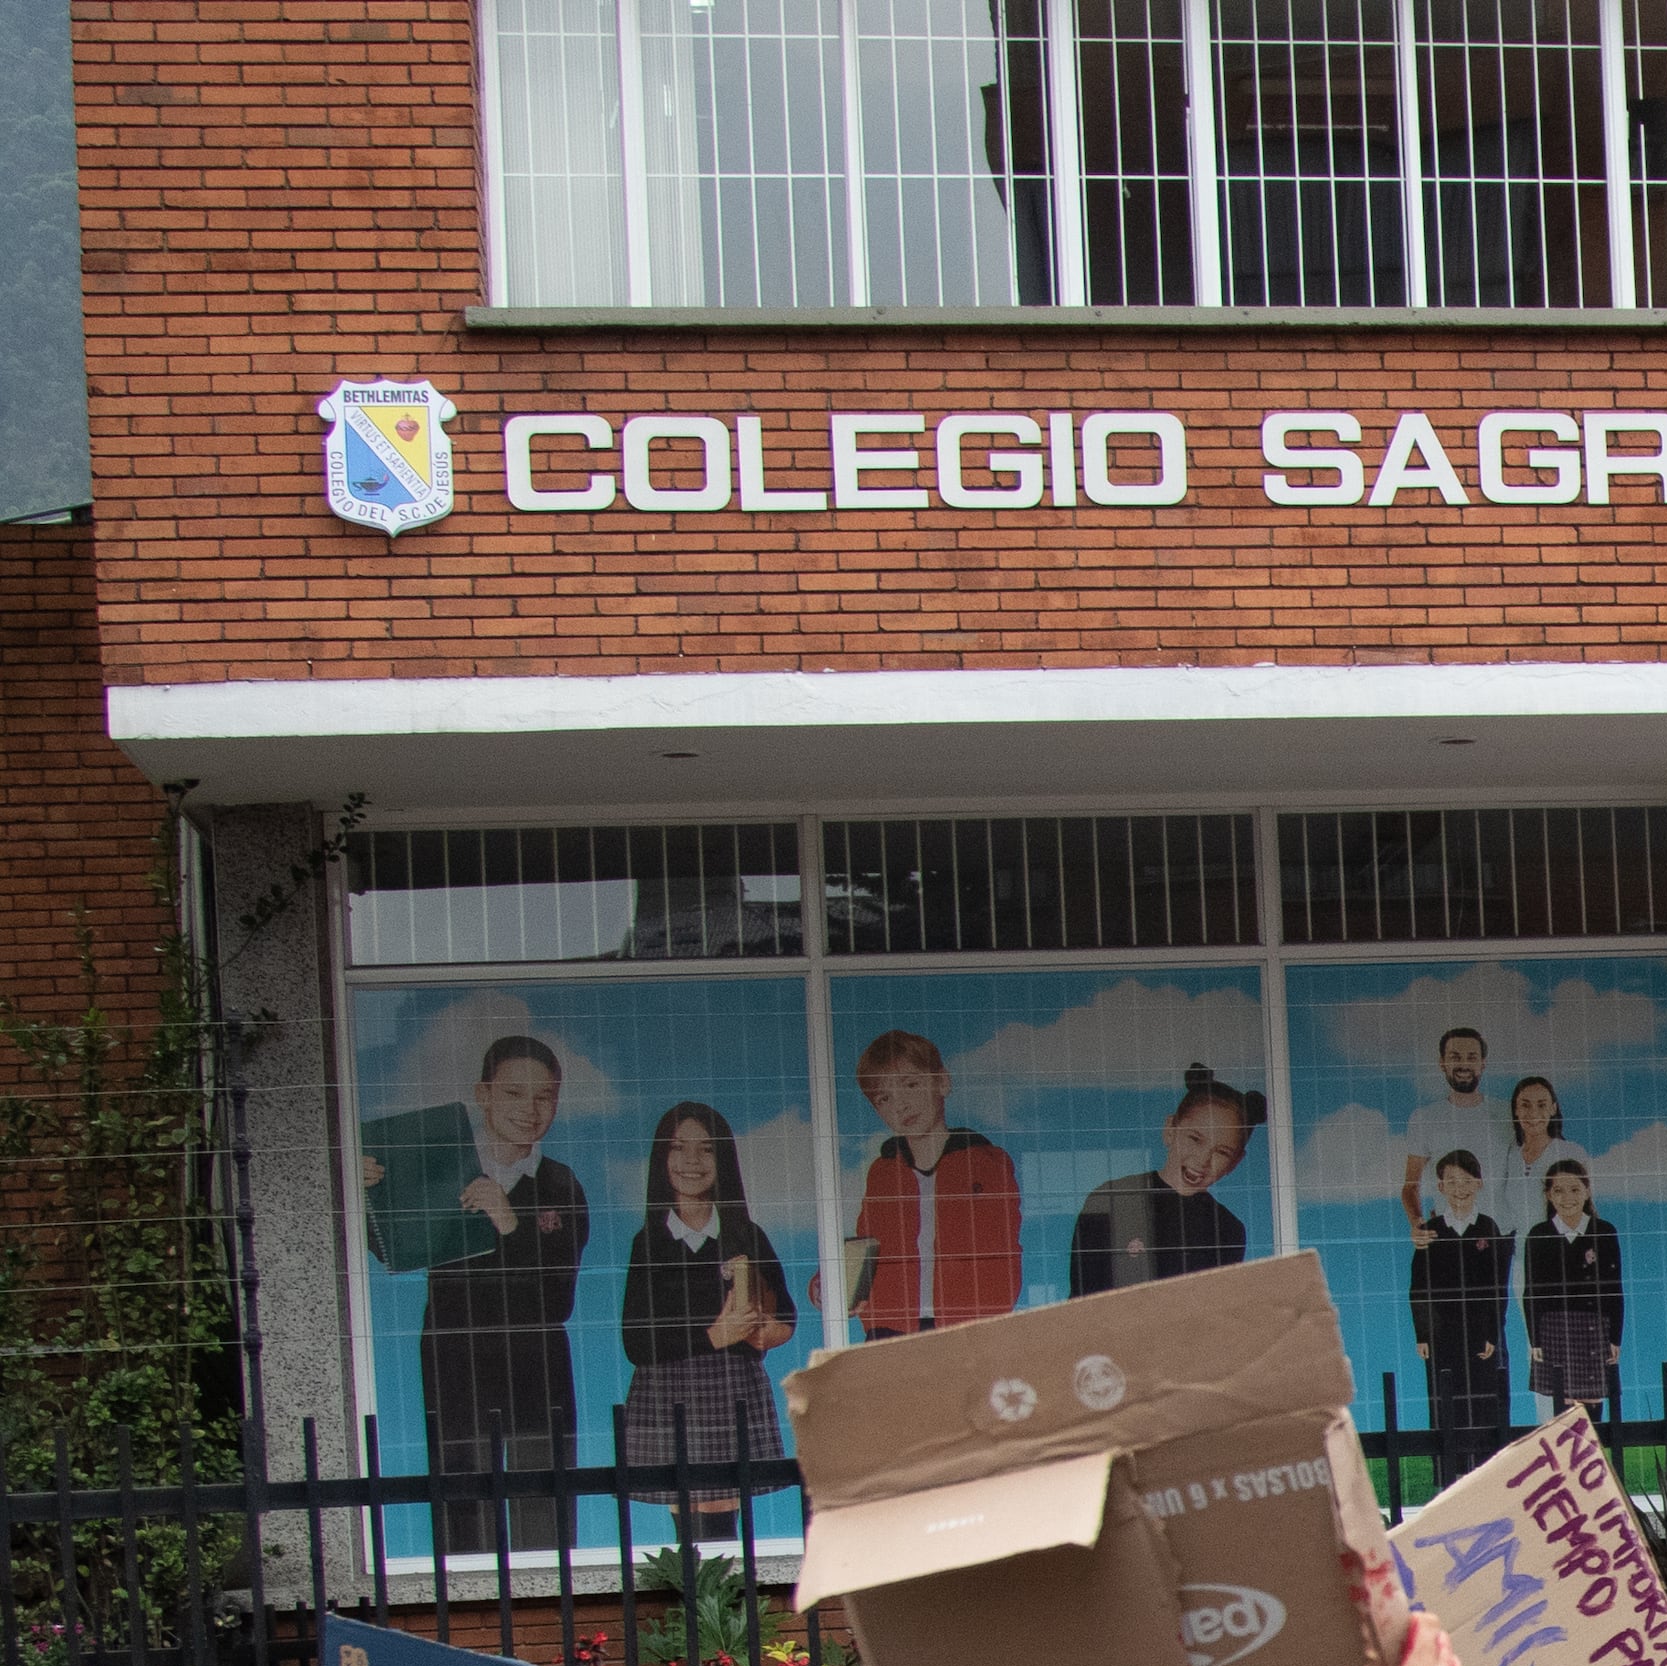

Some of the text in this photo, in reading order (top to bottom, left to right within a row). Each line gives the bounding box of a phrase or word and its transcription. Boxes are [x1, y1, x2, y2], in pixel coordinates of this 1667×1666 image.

[344, 390, 430, 404] BETHLEMITAS
[330, 451, 354, 512] COLEGIO
[357, 504, 387, 521] DEL
[426, 497, 446, 513] DE
[350, 410, 428, 498] VIRTUS ET SAPIENTIA
[506, 413, 1187, 511] COLEGIO
[1233, 1457, 1333, 1502] BOLSAS
[1556, 1416, 1609, 1491] NO
[1506, 1437, 1620, 1616] TIEMPO
